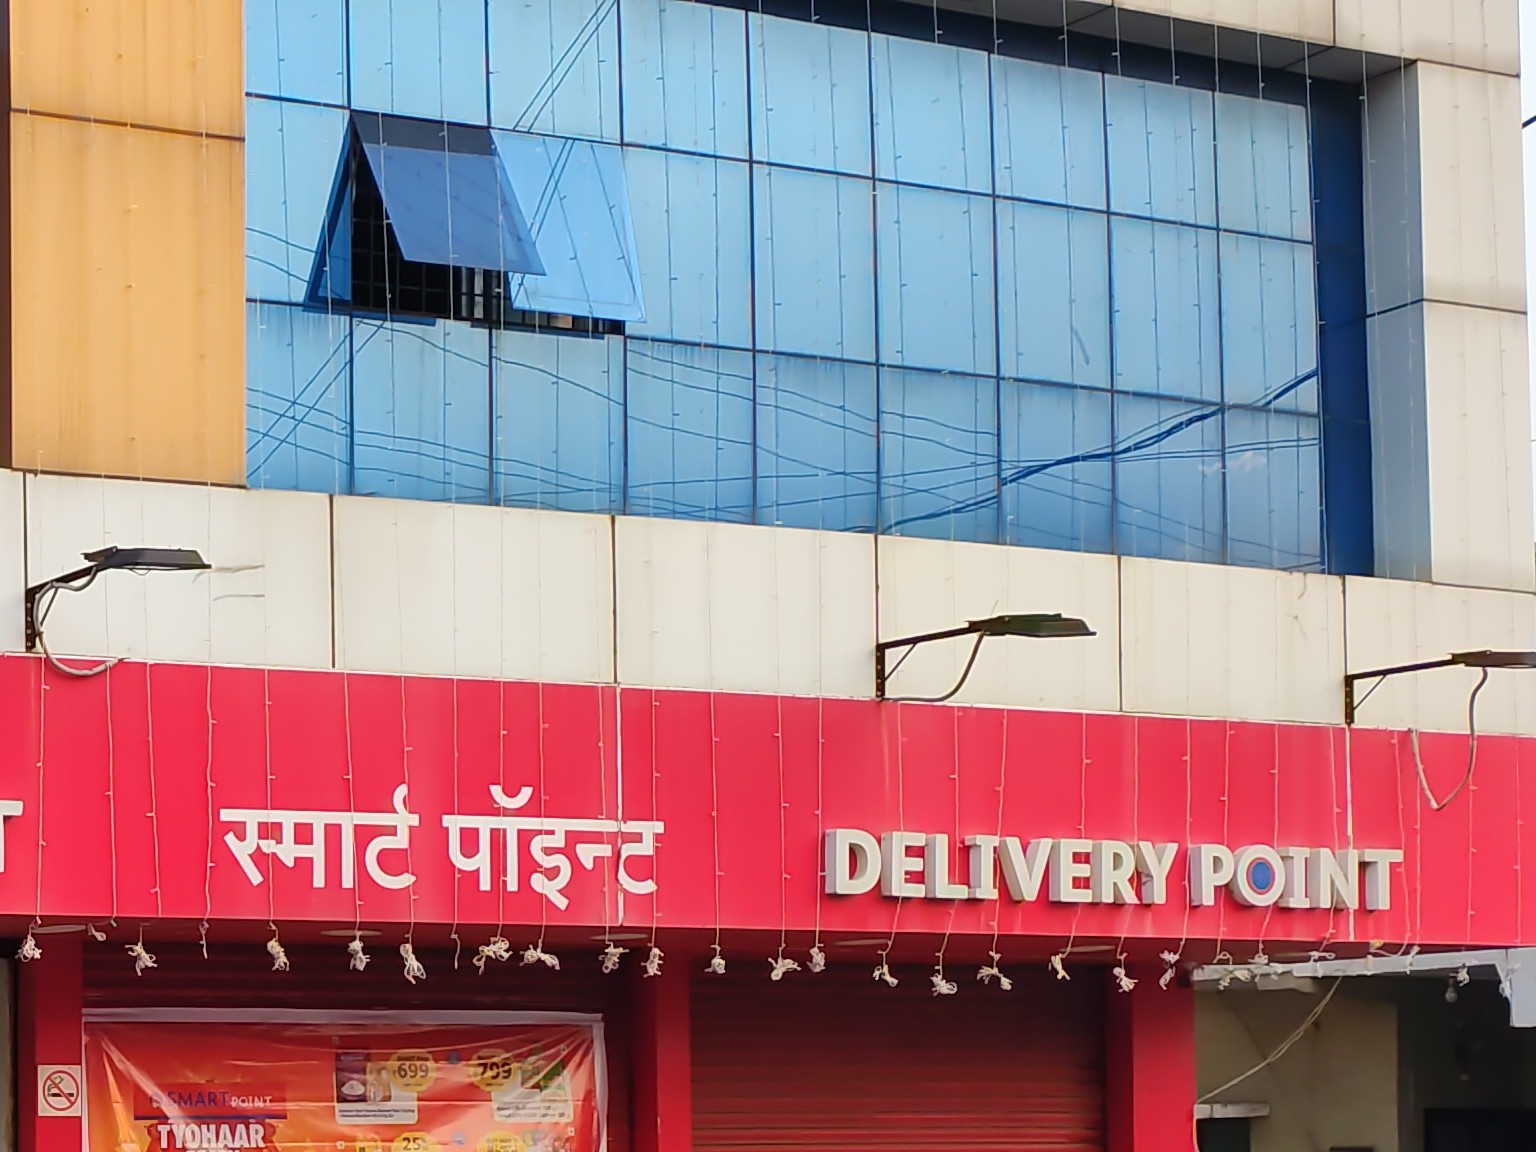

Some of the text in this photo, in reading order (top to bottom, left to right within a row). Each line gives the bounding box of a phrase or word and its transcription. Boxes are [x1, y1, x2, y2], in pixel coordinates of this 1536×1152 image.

[219, 782, 665, 911] स्मार्ट पॉइन्ट
[823, 827, 1404, 911] DELIVERY POINT
[167, 1091, 273, 1108] SMART POINT
[157, 1121, 266, 1149] TYOHAAR
